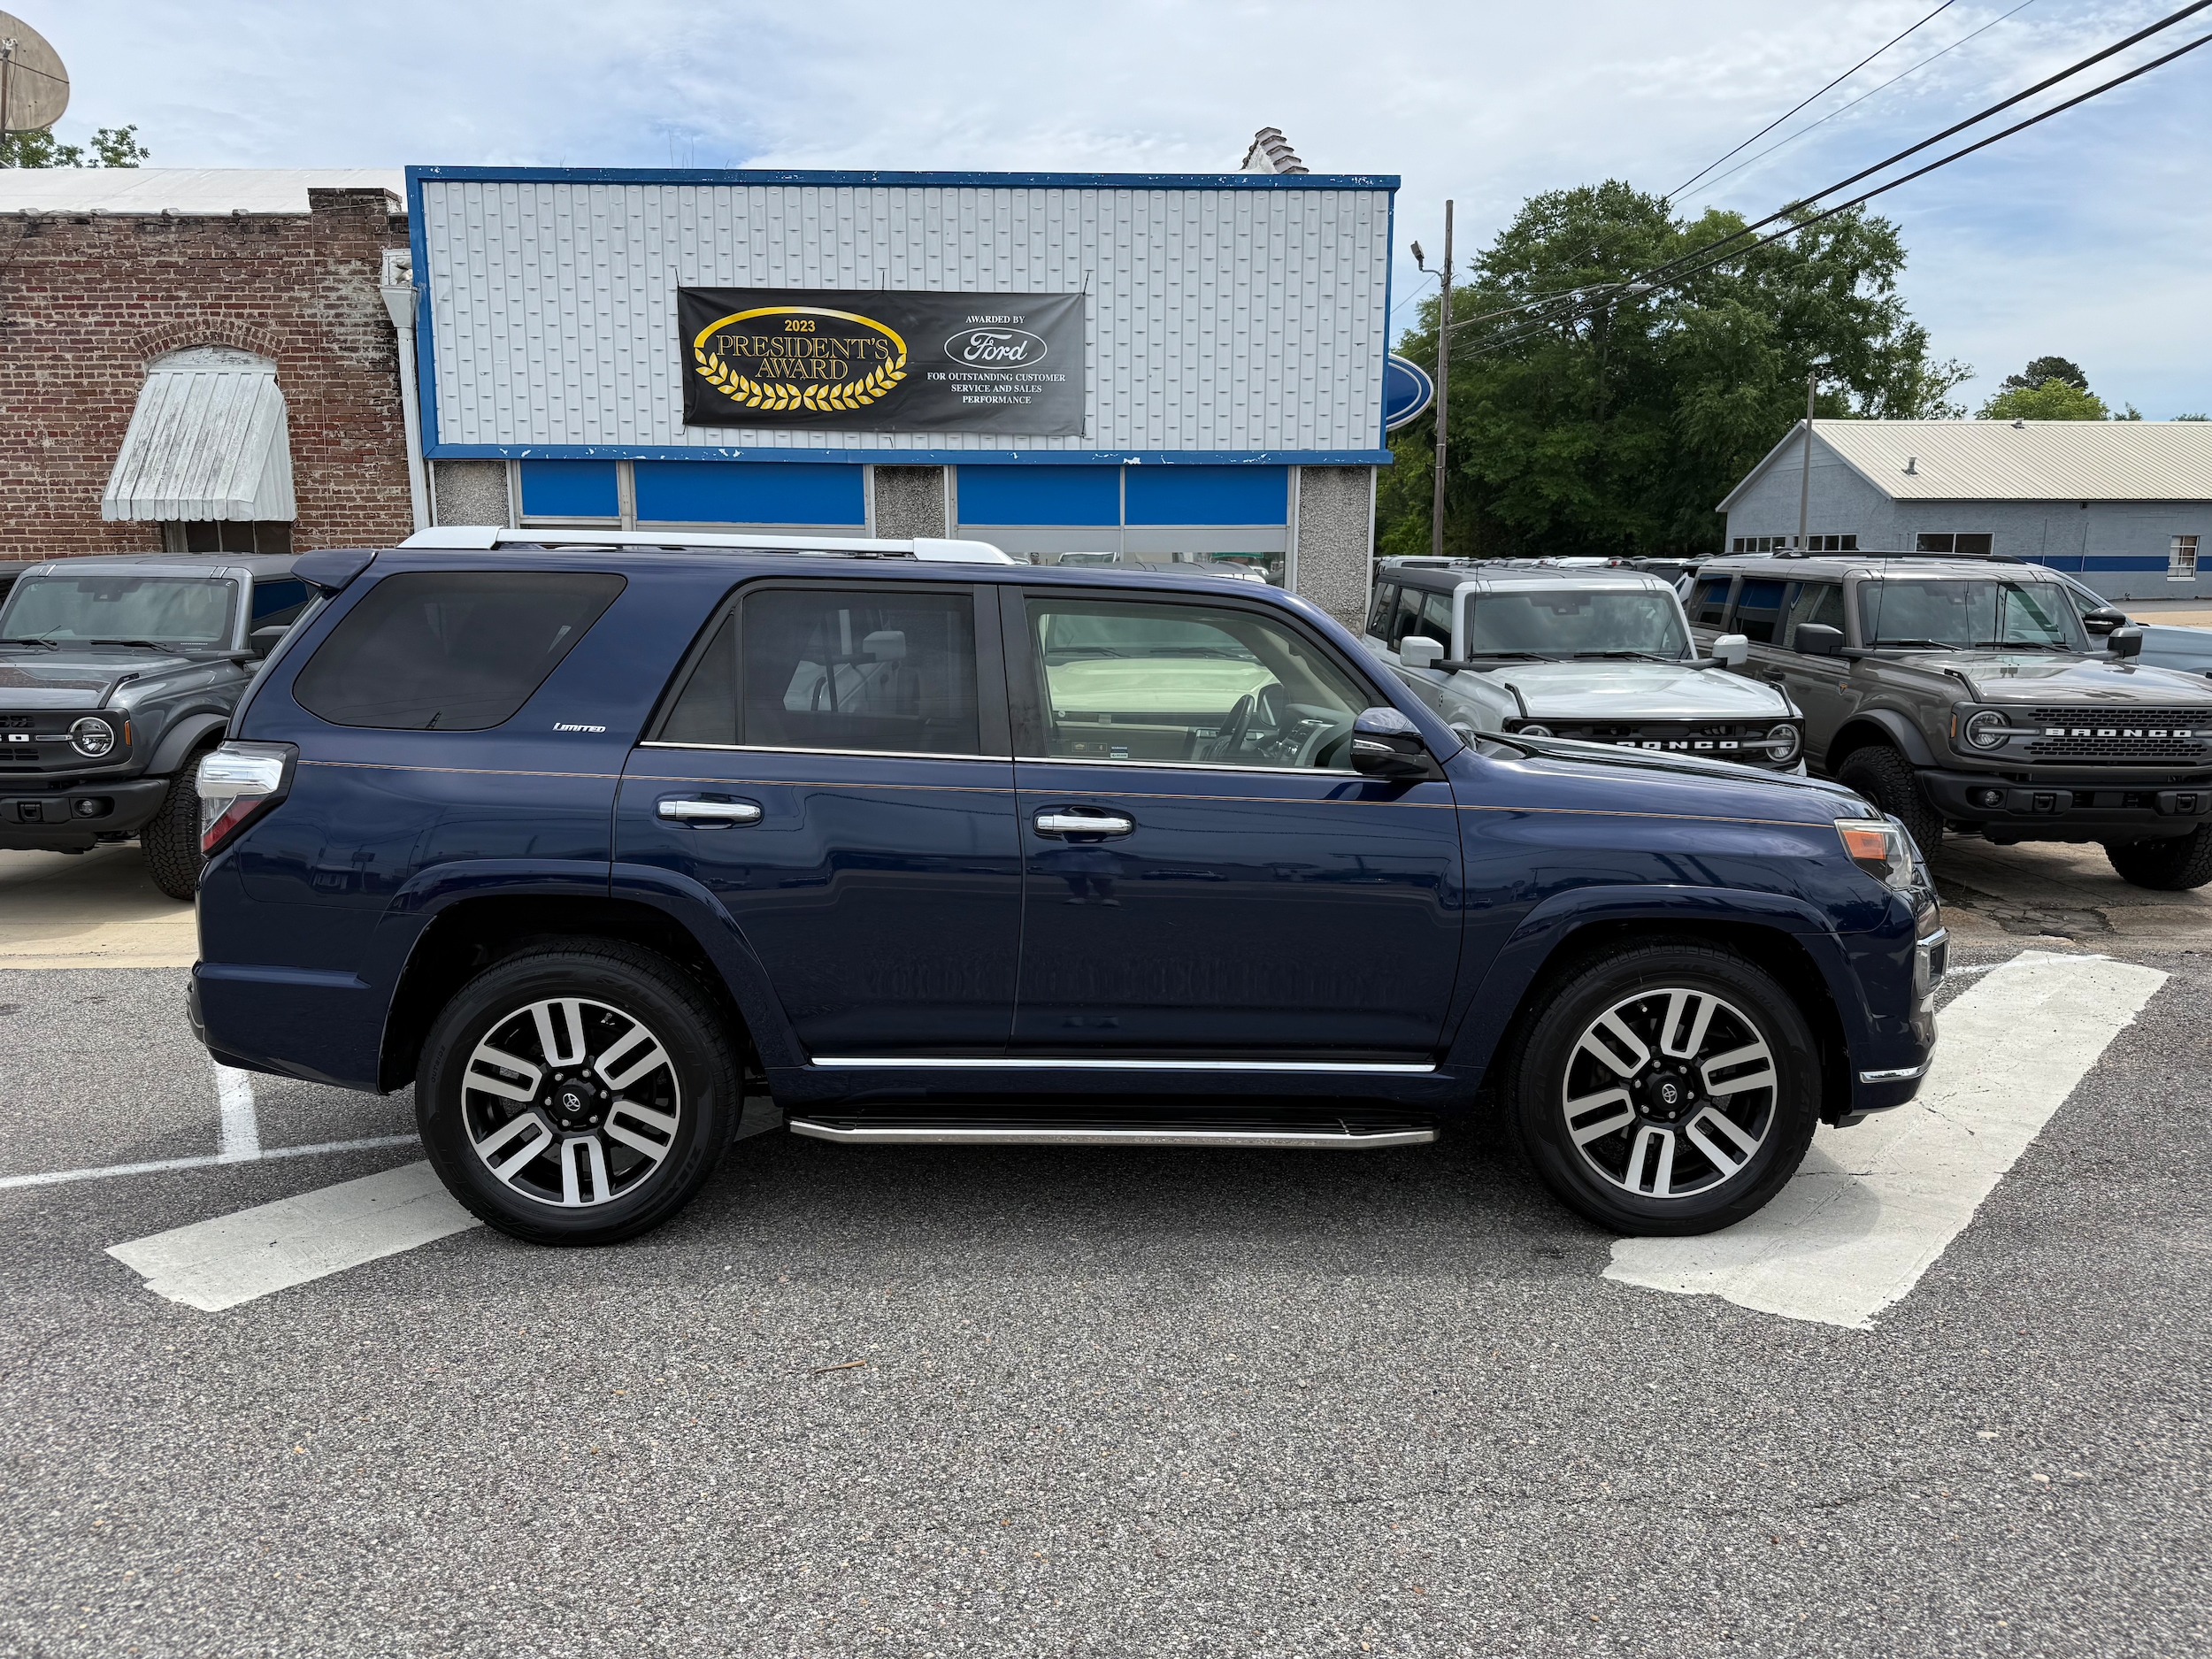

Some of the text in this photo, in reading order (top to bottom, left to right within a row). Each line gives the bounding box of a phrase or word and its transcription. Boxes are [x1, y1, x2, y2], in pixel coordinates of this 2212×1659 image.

[965, 315, 1025, 324] AWARDED BY
[784, 319, 816, 333] 2023
[716, 334, 889, 360] PRESIDENT'S
[964, 332, 1028, 361] Ford
[755, 357, 849, 380] AWARD
[926, 372, 1066, 383] FOR OUTSTANDING CUSTOMER
[950, 384, 1042, 394] SERVICE AND SALES
[962, 396, 1032, 404] PERFORMANCE
[2045, 728, 2192, 738] BRONCO
